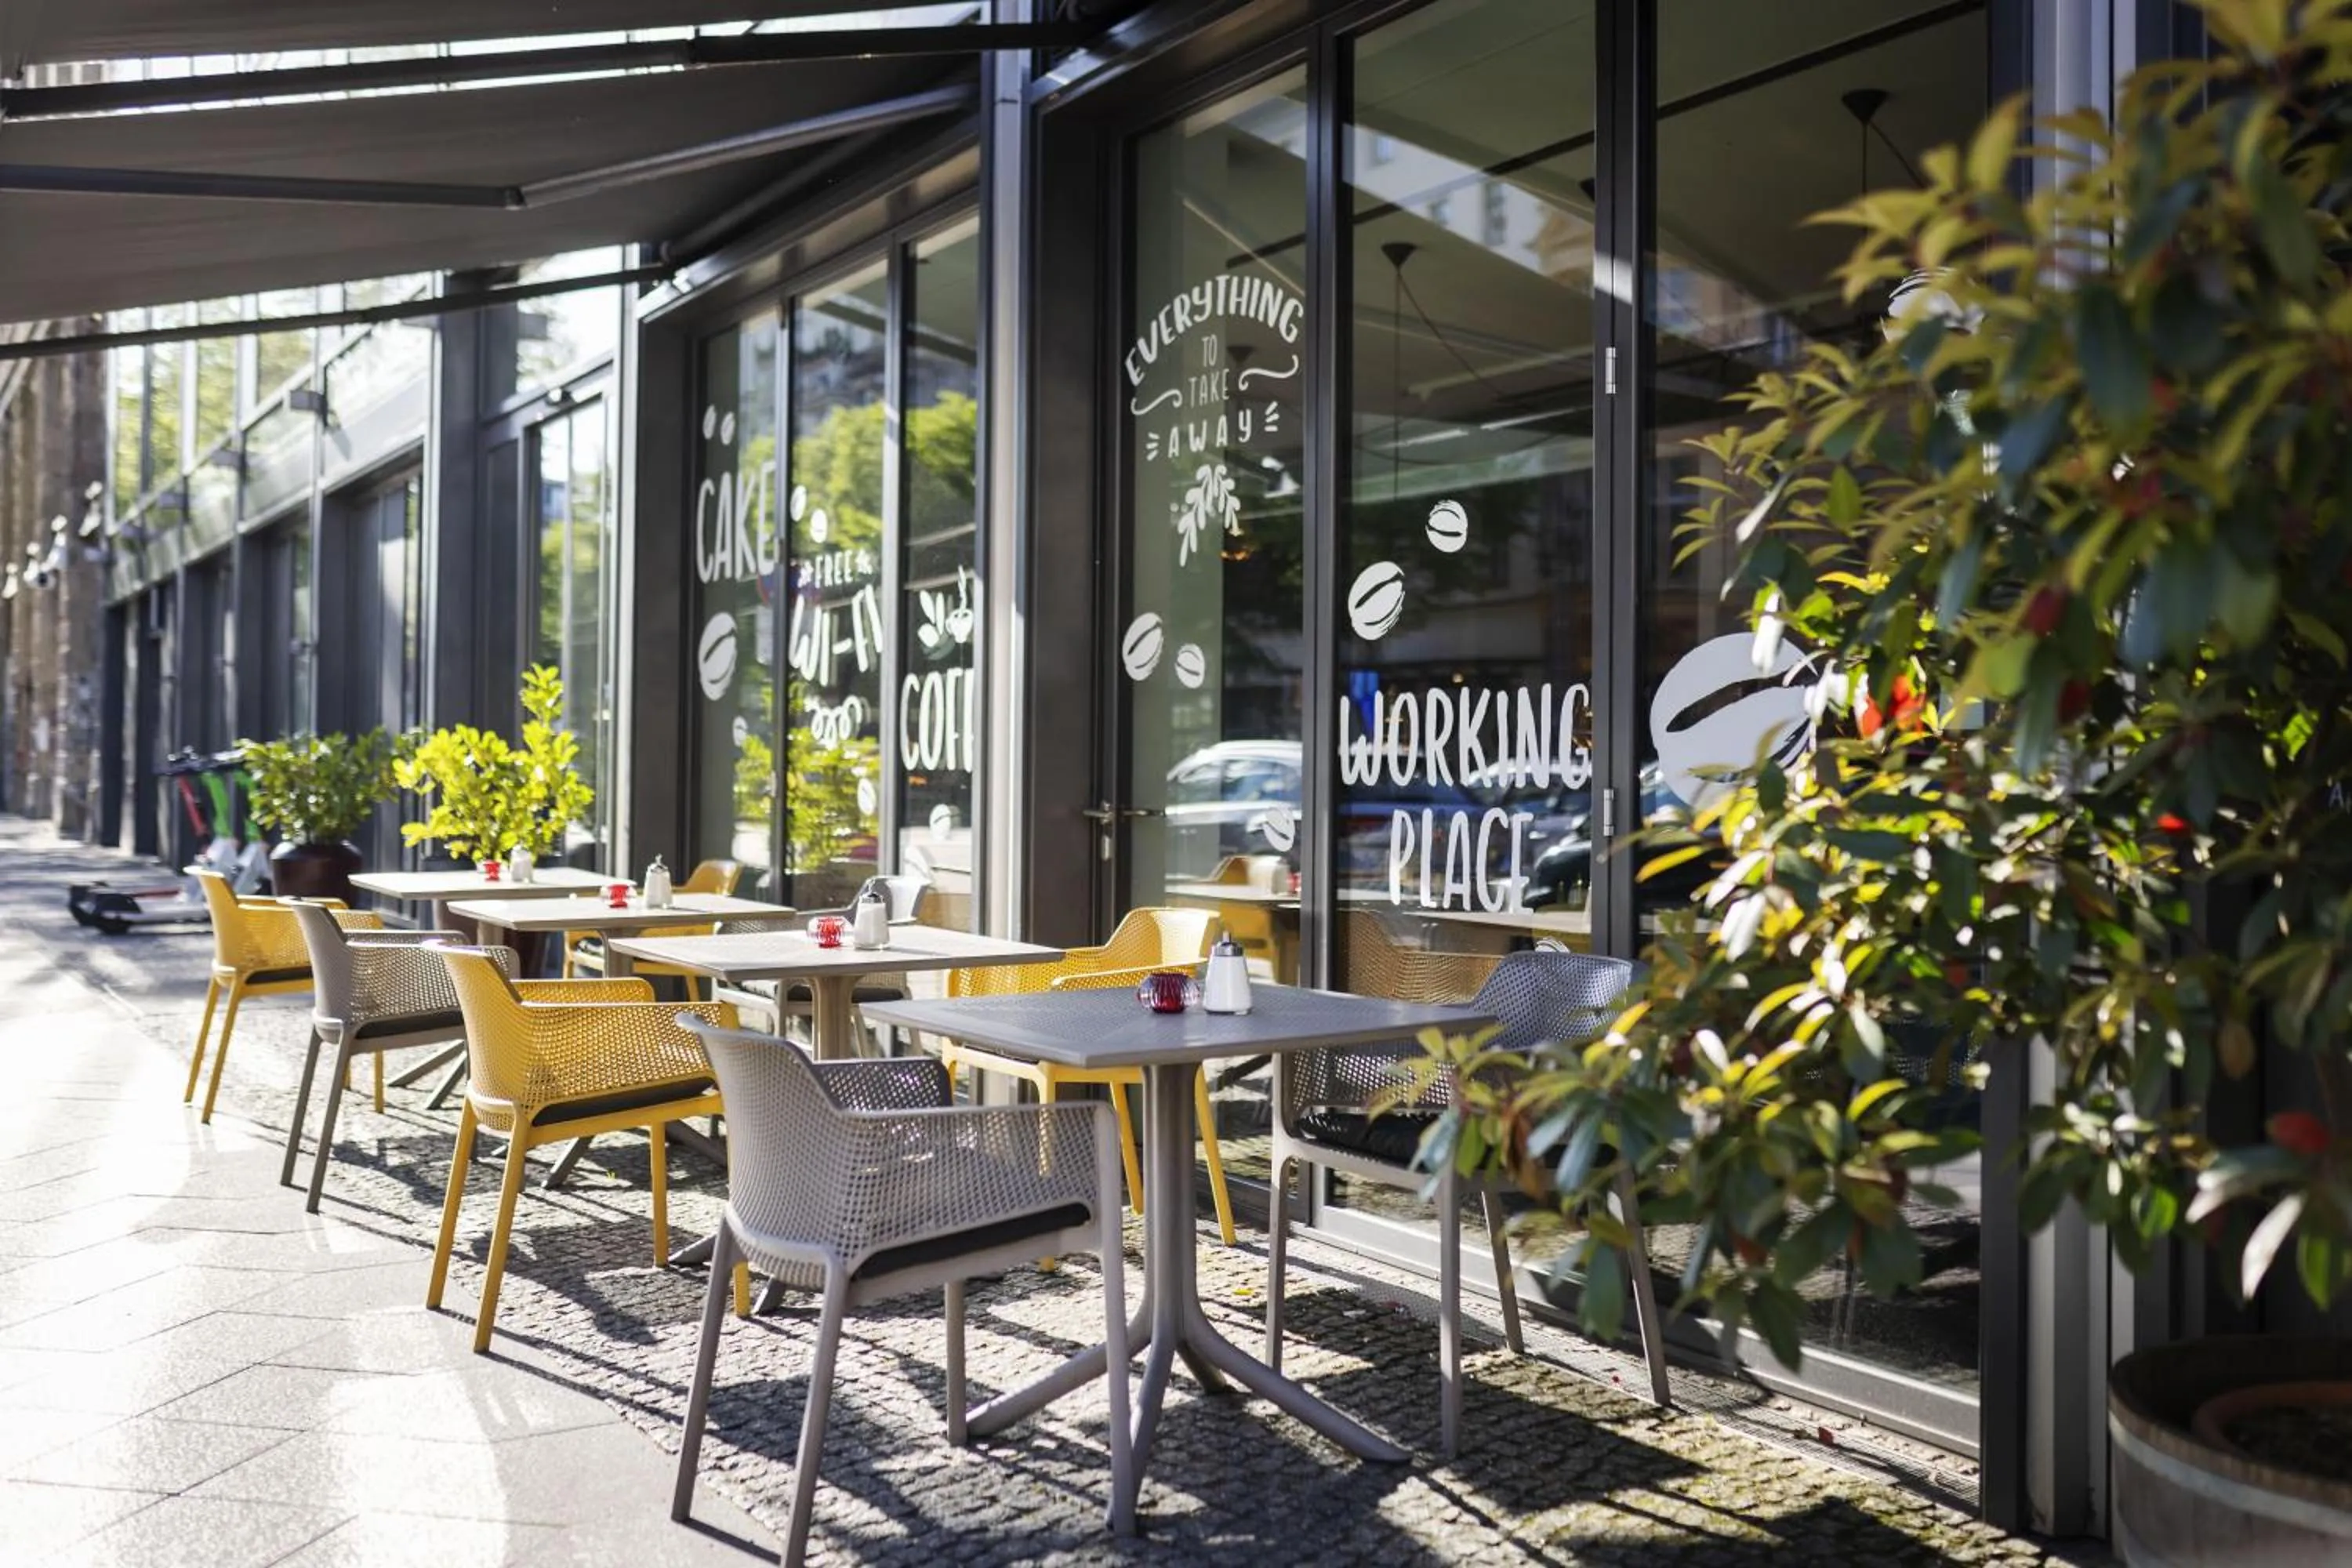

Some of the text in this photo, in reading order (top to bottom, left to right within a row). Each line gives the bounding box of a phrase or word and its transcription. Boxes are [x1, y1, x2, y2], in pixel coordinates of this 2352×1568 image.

[1124, 275, 1304, 386] EVERYTHING
[1201, 334, 1218, 367] TO
[1168, 408, 1251, 458] AWAY
[1189, 368, 1230, 408] TAKE
[696, 461, 777, 584] CAKE
[815, 550, 853, 588] FREE
[789, 584, 884, 687] WI-FI
[1339, 683, 1590, 789] WORKING
[1388, 807, 1534, 915] PLACE
